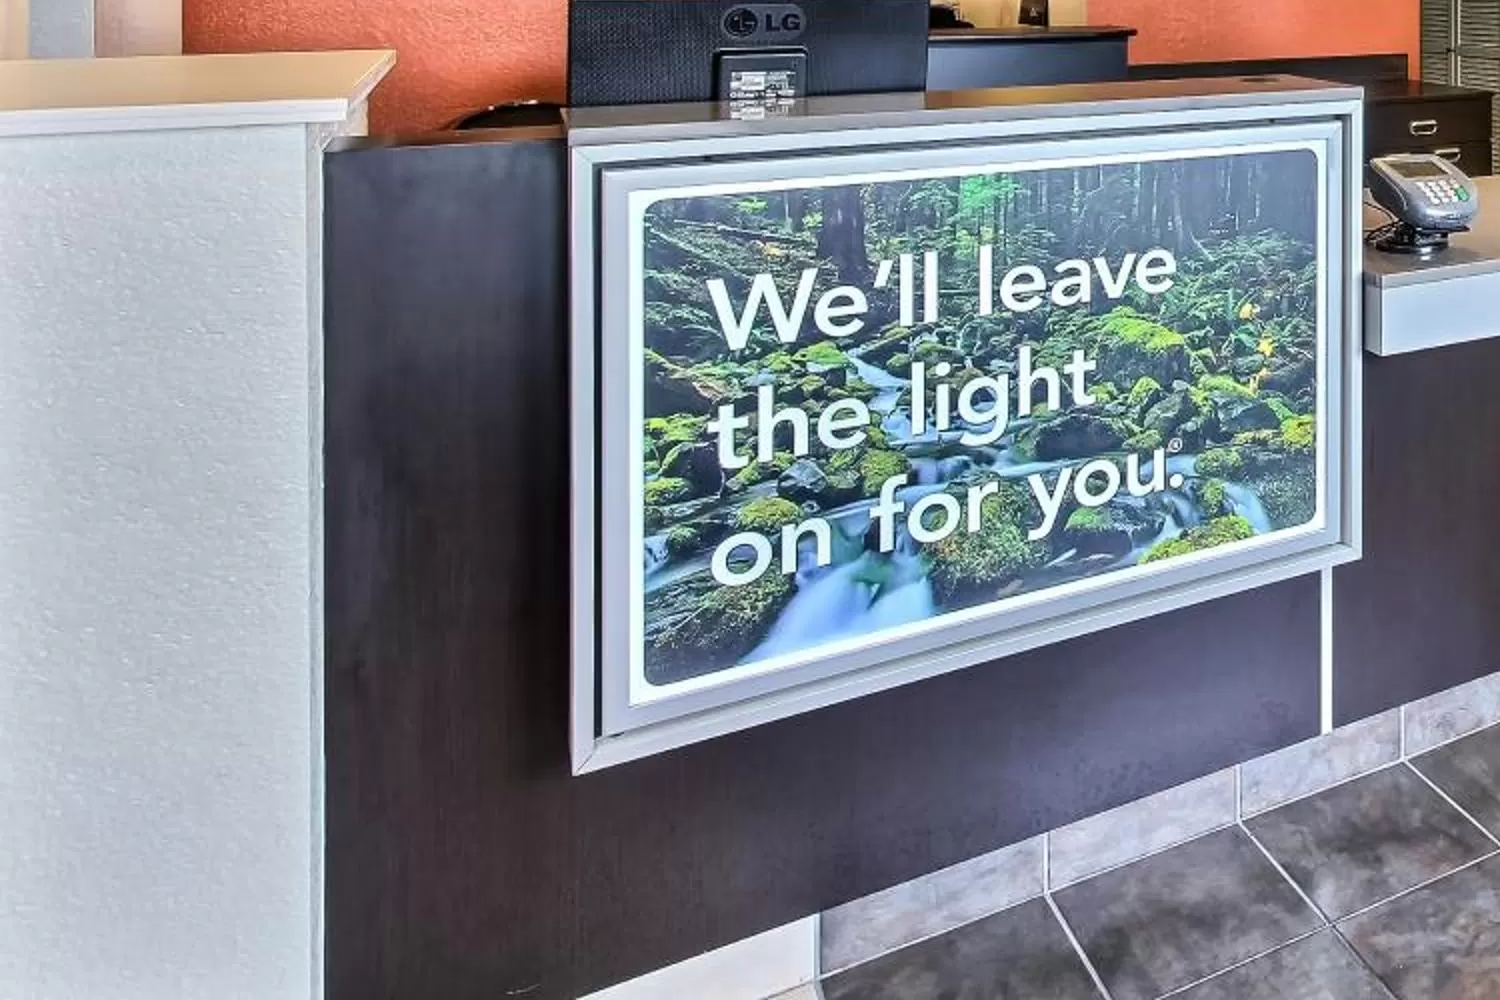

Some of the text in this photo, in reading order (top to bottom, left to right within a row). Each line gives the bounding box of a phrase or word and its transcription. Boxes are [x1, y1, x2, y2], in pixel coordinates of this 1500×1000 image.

[765, 13, 801, 32] LG
[705, 244, 1177, 351] We'll leave
[706, 345, 1097, 470] the light
[710, 449, 1185, 587] on for you.
